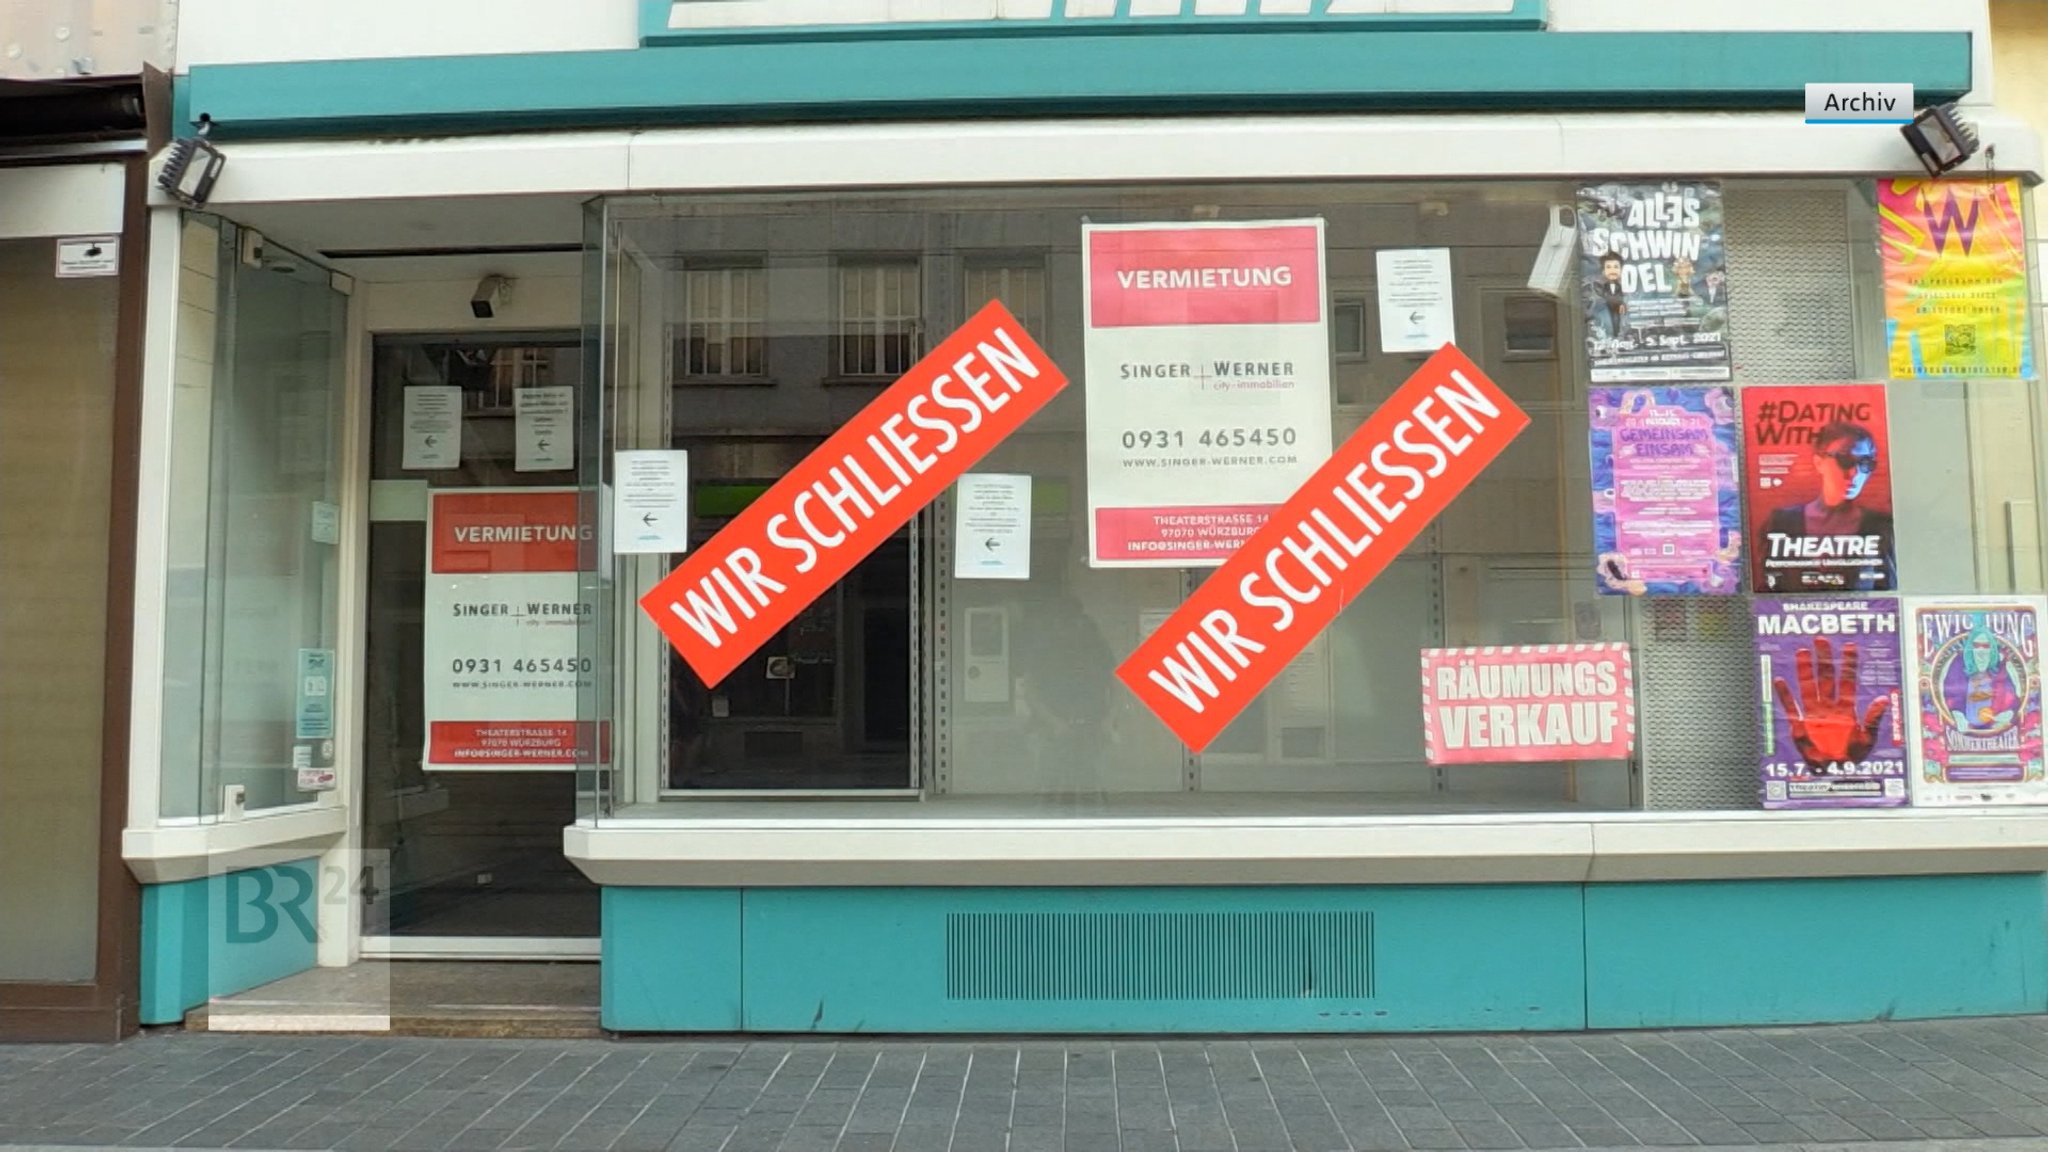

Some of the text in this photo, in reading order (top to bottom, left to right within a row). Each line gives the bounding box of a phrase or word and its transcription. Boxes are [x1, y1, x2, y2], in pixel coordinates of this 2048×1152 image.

[1592, 228, 1700, 262] SCHWIN
[1117, 266, 1293, 290] VERMIETUNG
[1120, 360, 1295, 380] SINGER WERNER
[1758, 400, 1870, 424] #DATING
[1121, 427, 1297, 449] 0931 465450
[1620, 428, 1709, 442] GEMEINSAM
[1756, 423, 1822, 446] WITH
[1635, 443, 1694, 457] EINSAM
[1121, 455, 1298, 469] WWW.SINGER-WERNER.COM
[670, 327, 1040, 649] WIR SCHLIESSEN
[1153, 513, 1270, 526] THEATERSTRASSE 14
[454, 525, 593, 543] VERMIETUNG
[1148, 369, 1501, 714] WIR SCHLIESSEN
[1161, 528, 1195, 539] 97070
[1766, 532, 1881, 558] THEATRE
[452, 602, 593, 618] SINGER WERNER
[1783, 601, 1869, 612] SHAKESPEARE
[1757, 613, 1896, 635] MACBETH
[452, 658, 593, 674] 0931 465450
[1436, 659, 1618, 700] RÄUMUNGS
[1438, 701, 1619, 749] VERKAUF
[1765, 763, 1812, 778] 15.7.
[1826, 760, 1904, 776] 4.9.2021
